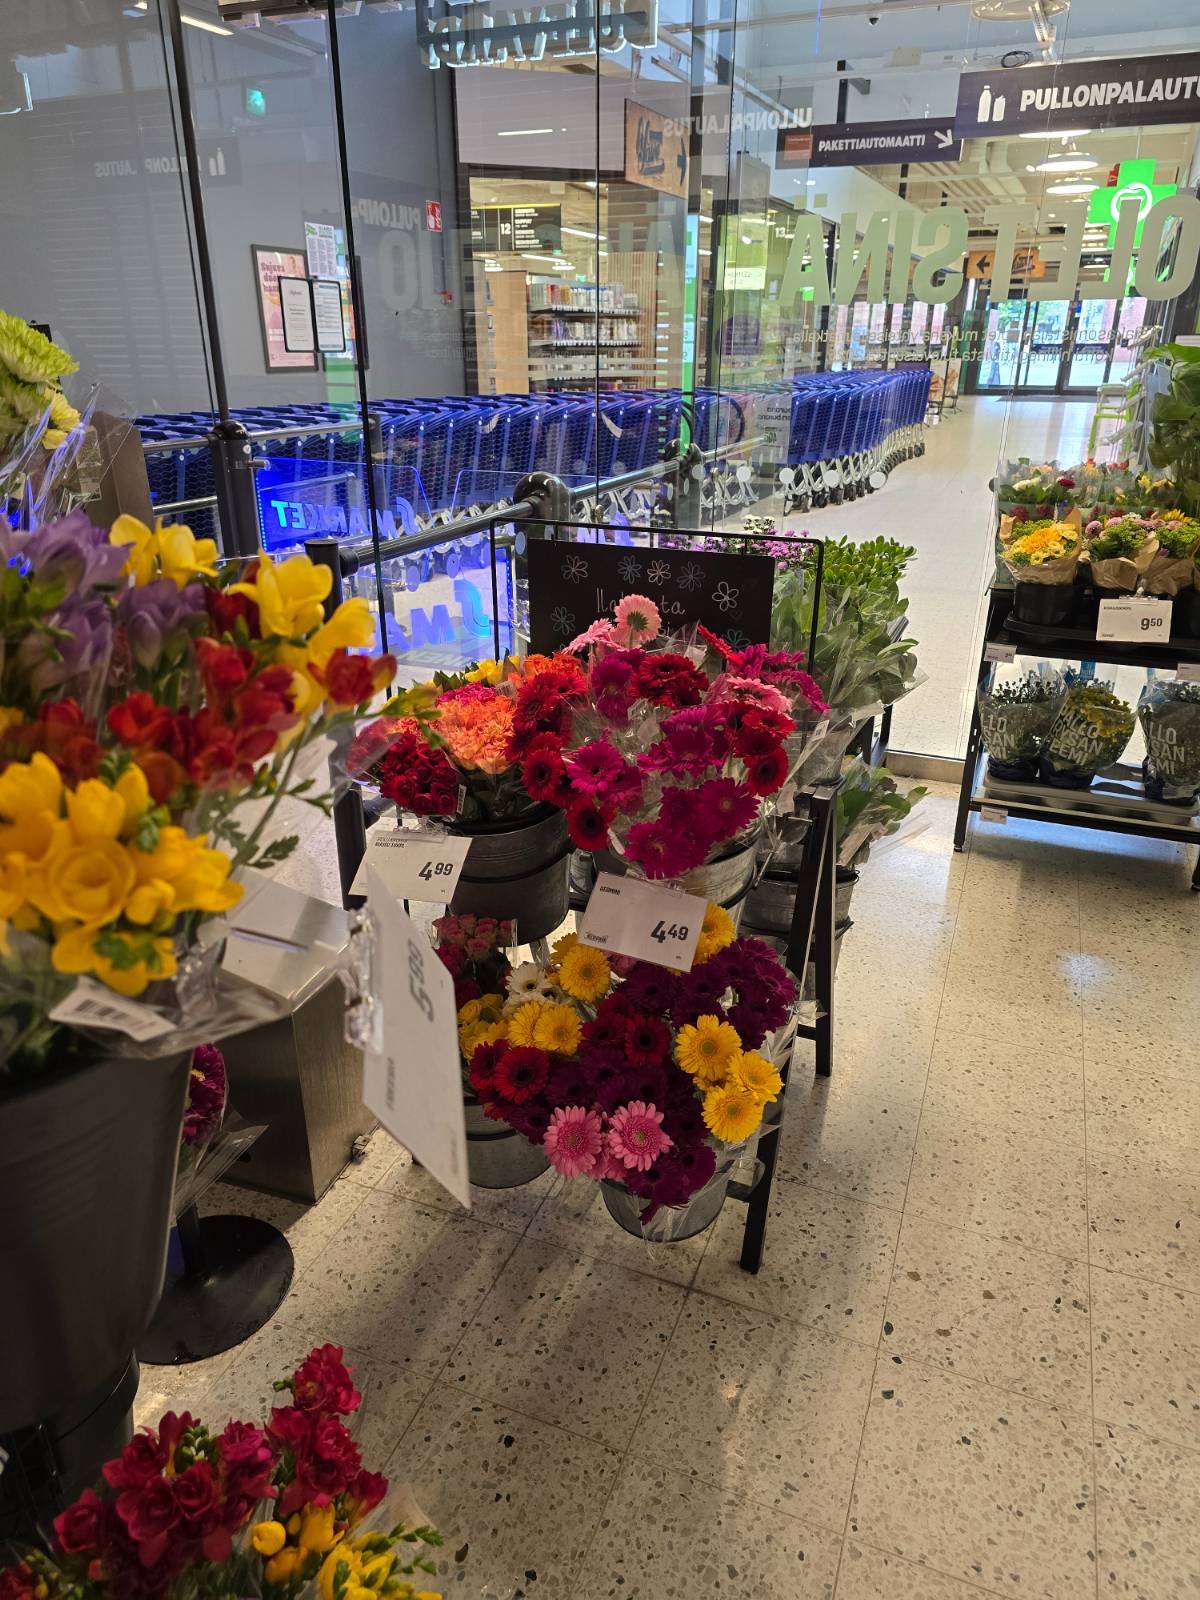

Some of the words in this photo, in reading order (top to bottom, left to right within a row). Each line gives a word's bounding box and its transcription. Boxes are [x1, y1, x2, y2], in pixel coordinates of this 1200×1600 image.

[1020, 75, 1200, 112] PULLONPALAUT
[818, 134, 926, 152] PAKETTIAUTOMAATTI
[500, 223, 512, 235] 12
[983, 729, 1015, 748] SAN
[1053, 718, 1105, 756] RYSAN
[1149, 720, 1177, 745] LLO
[1048, 737, 1089, 766] EEMI
[1151, 739, 1185, 763] SAN
